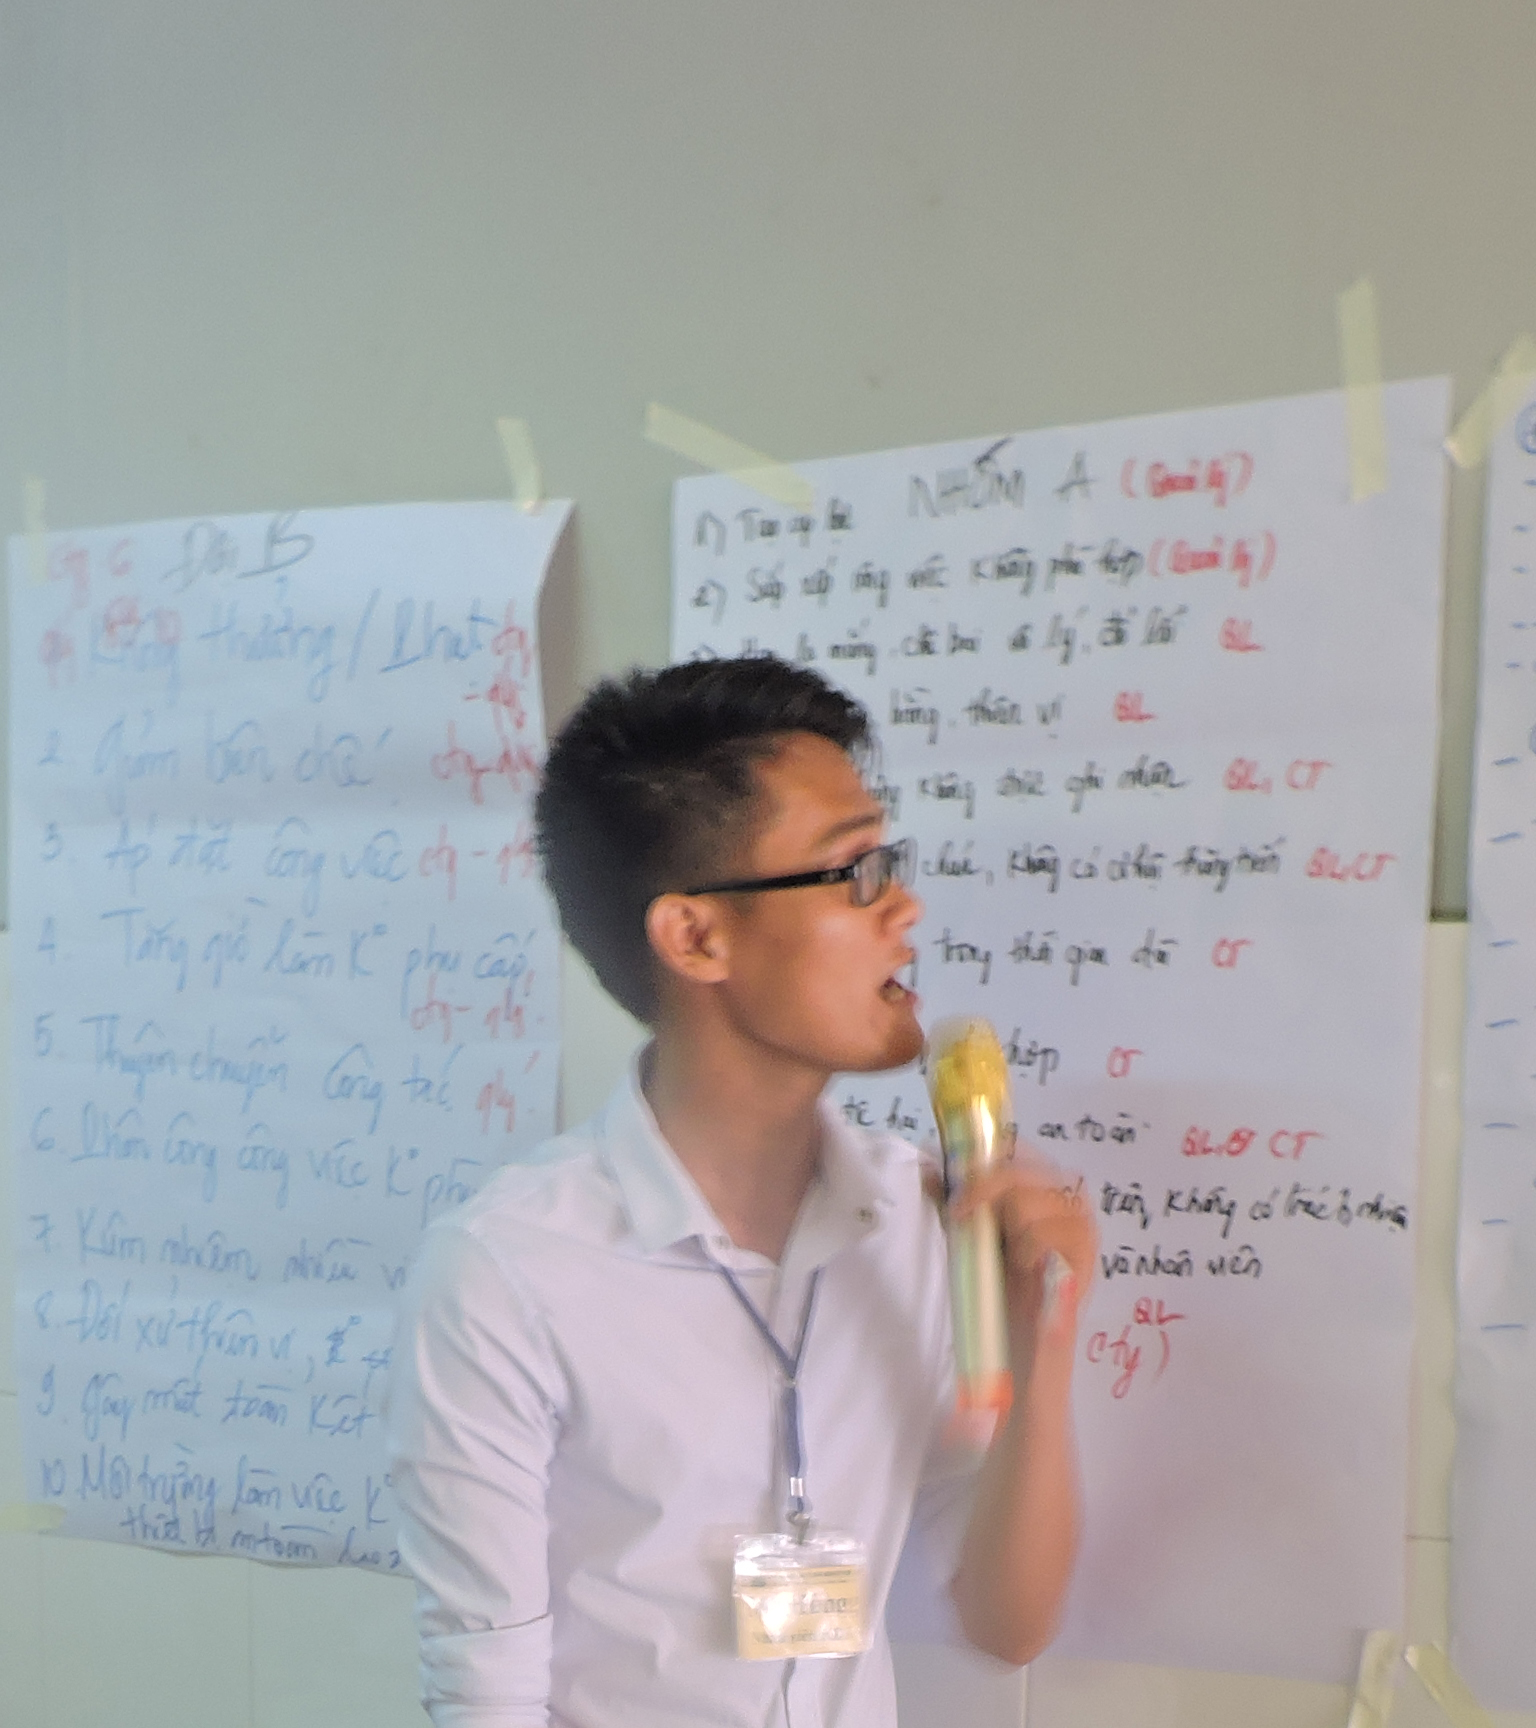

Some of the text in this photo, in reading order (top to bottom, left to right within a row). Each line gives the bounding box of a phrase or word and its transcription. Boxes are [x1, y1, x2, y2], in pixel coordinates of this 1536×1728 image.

[1052, 450, 1096, 502] A
[238, 511, 315, 579] B
[1113, 690, 1157, 723] QL
[1284, 758, 1336, 790] CT
[1038, 1121, 1067, 1141] an
[1268, 1128, 1328, 1160] CT
[1134, 1296, 1186, 1325] QL
